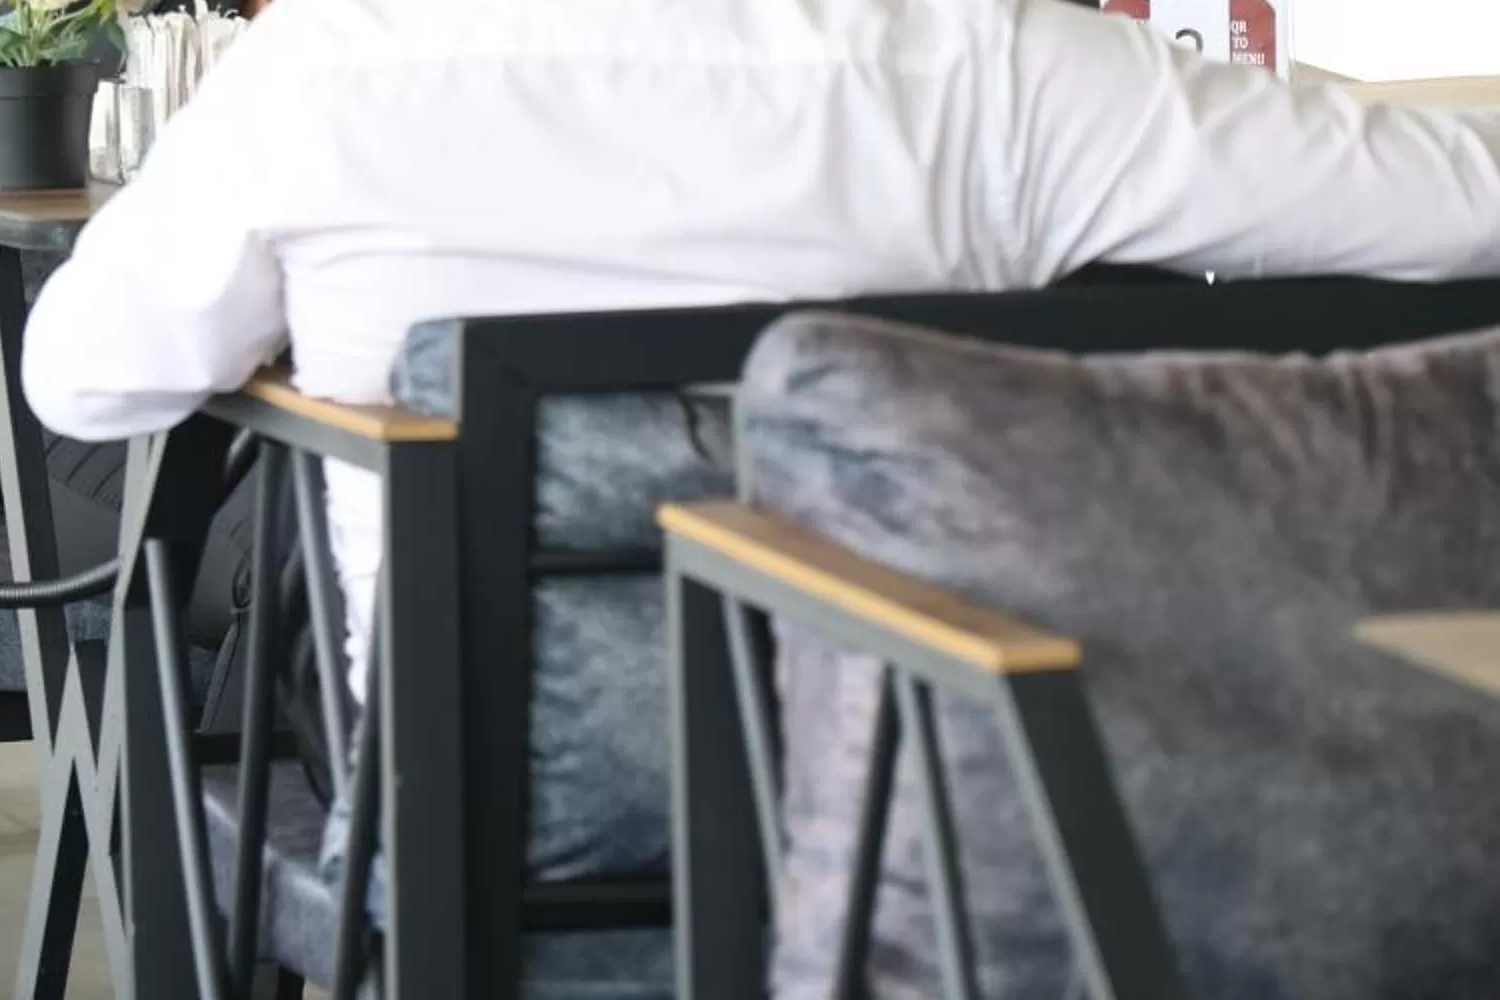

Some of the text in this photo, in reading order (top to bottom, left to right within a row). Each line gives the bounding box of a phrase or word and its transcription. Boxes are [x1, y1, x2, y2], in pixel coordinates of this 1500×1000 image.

[1231, 20, 1247, 34] QR
[1232, 37, 1249, 49] TO
[1232, 52, 1265, 65] MENU
